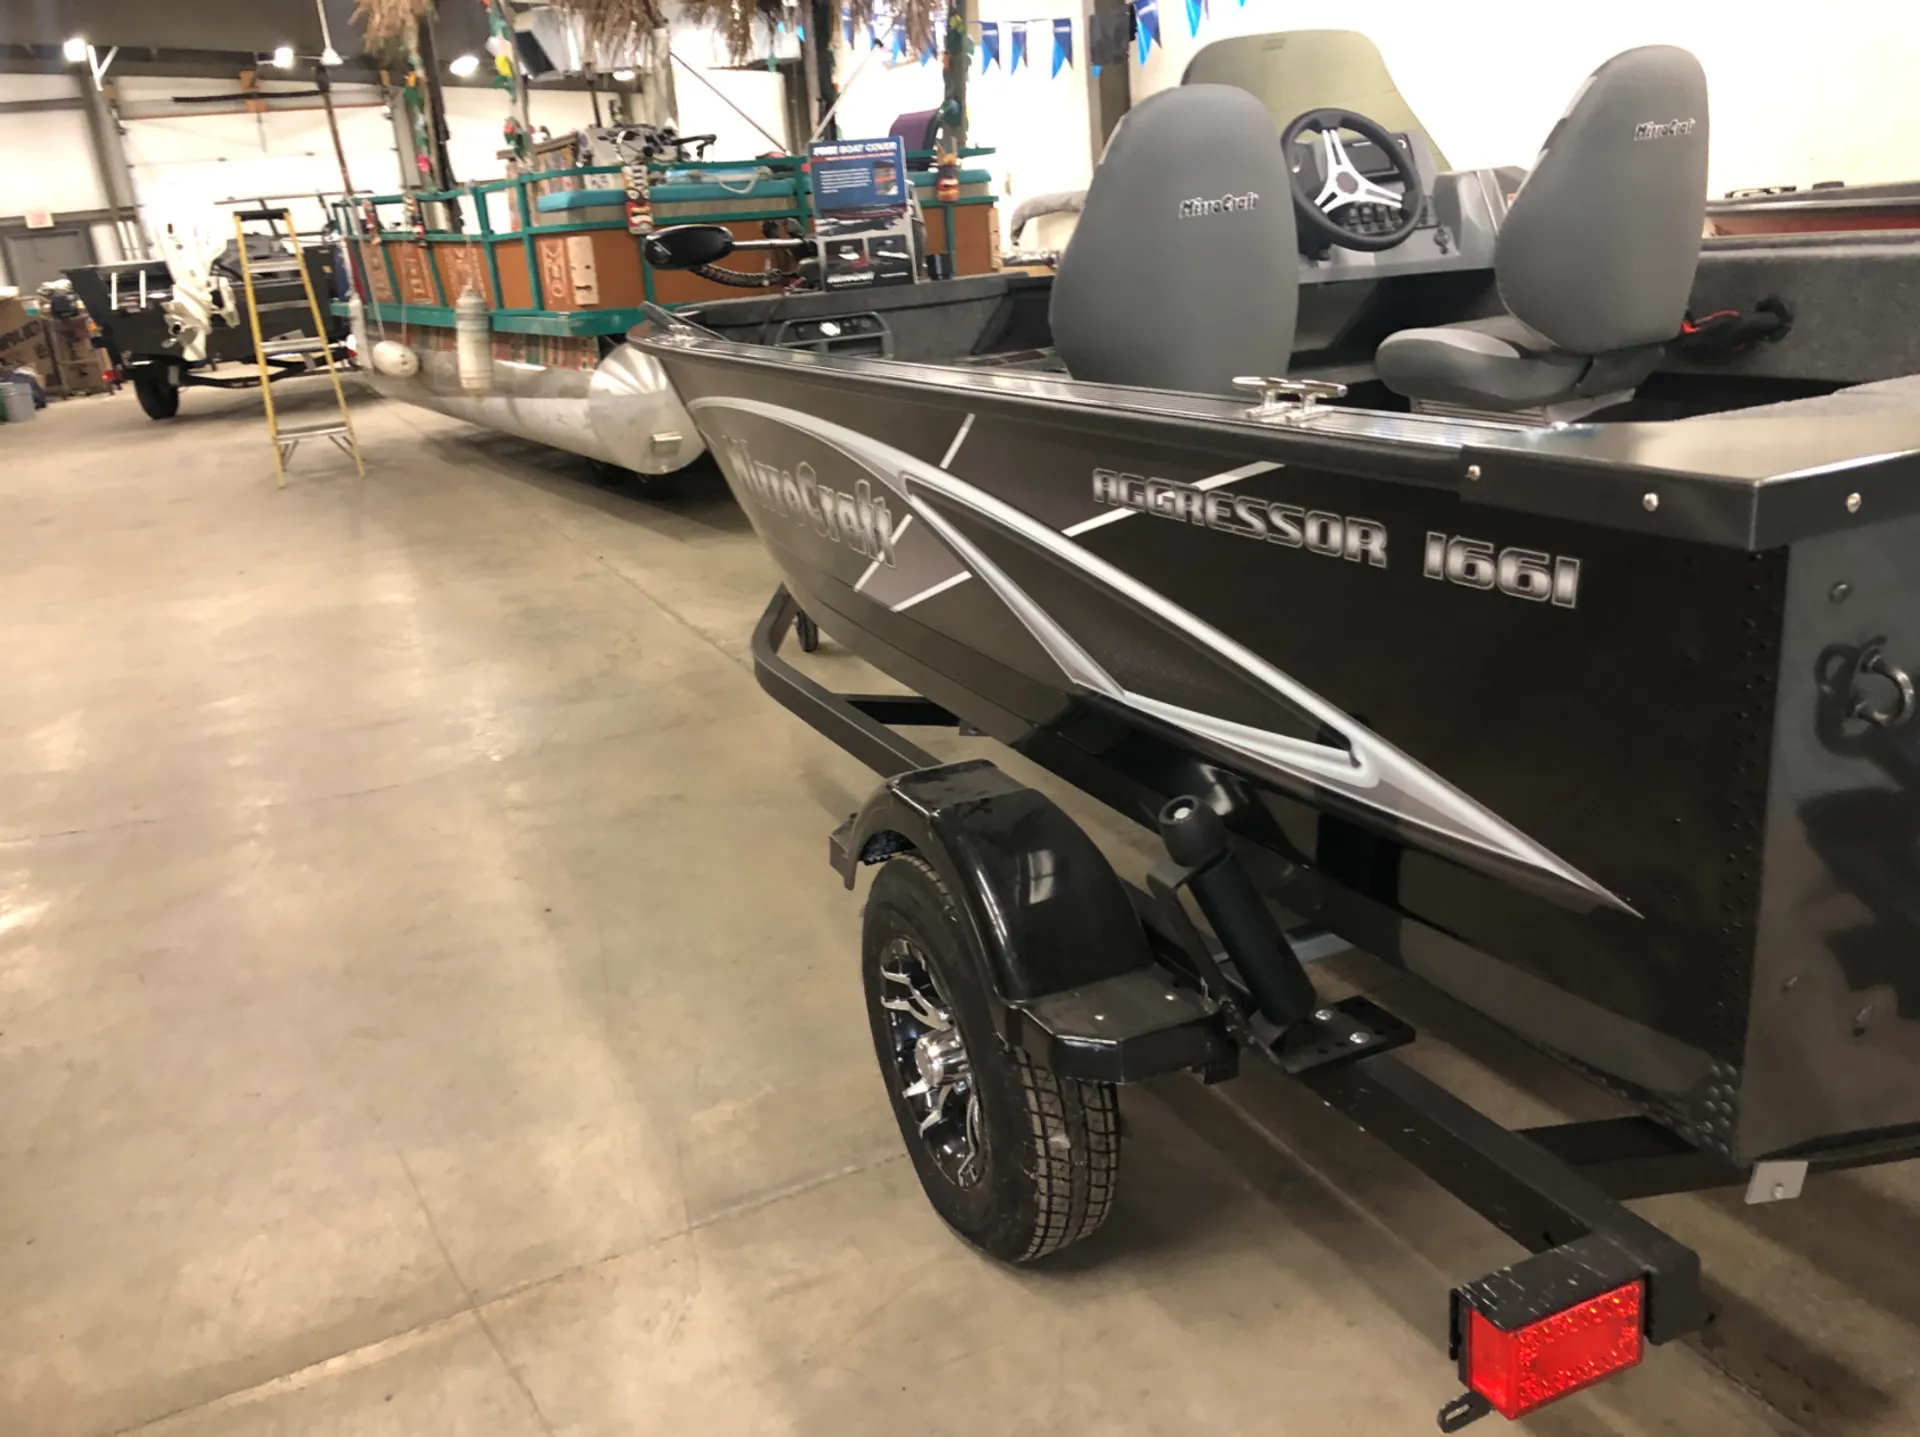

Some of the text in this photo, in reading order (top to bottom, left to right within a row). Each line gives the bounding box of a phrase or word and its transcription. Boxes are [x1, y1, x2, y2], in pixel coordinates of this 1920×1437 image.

[1178, 191, 1259, 219] MirroCraft
[1092, 467, 1580, 609] AGGRESSOR 1661
